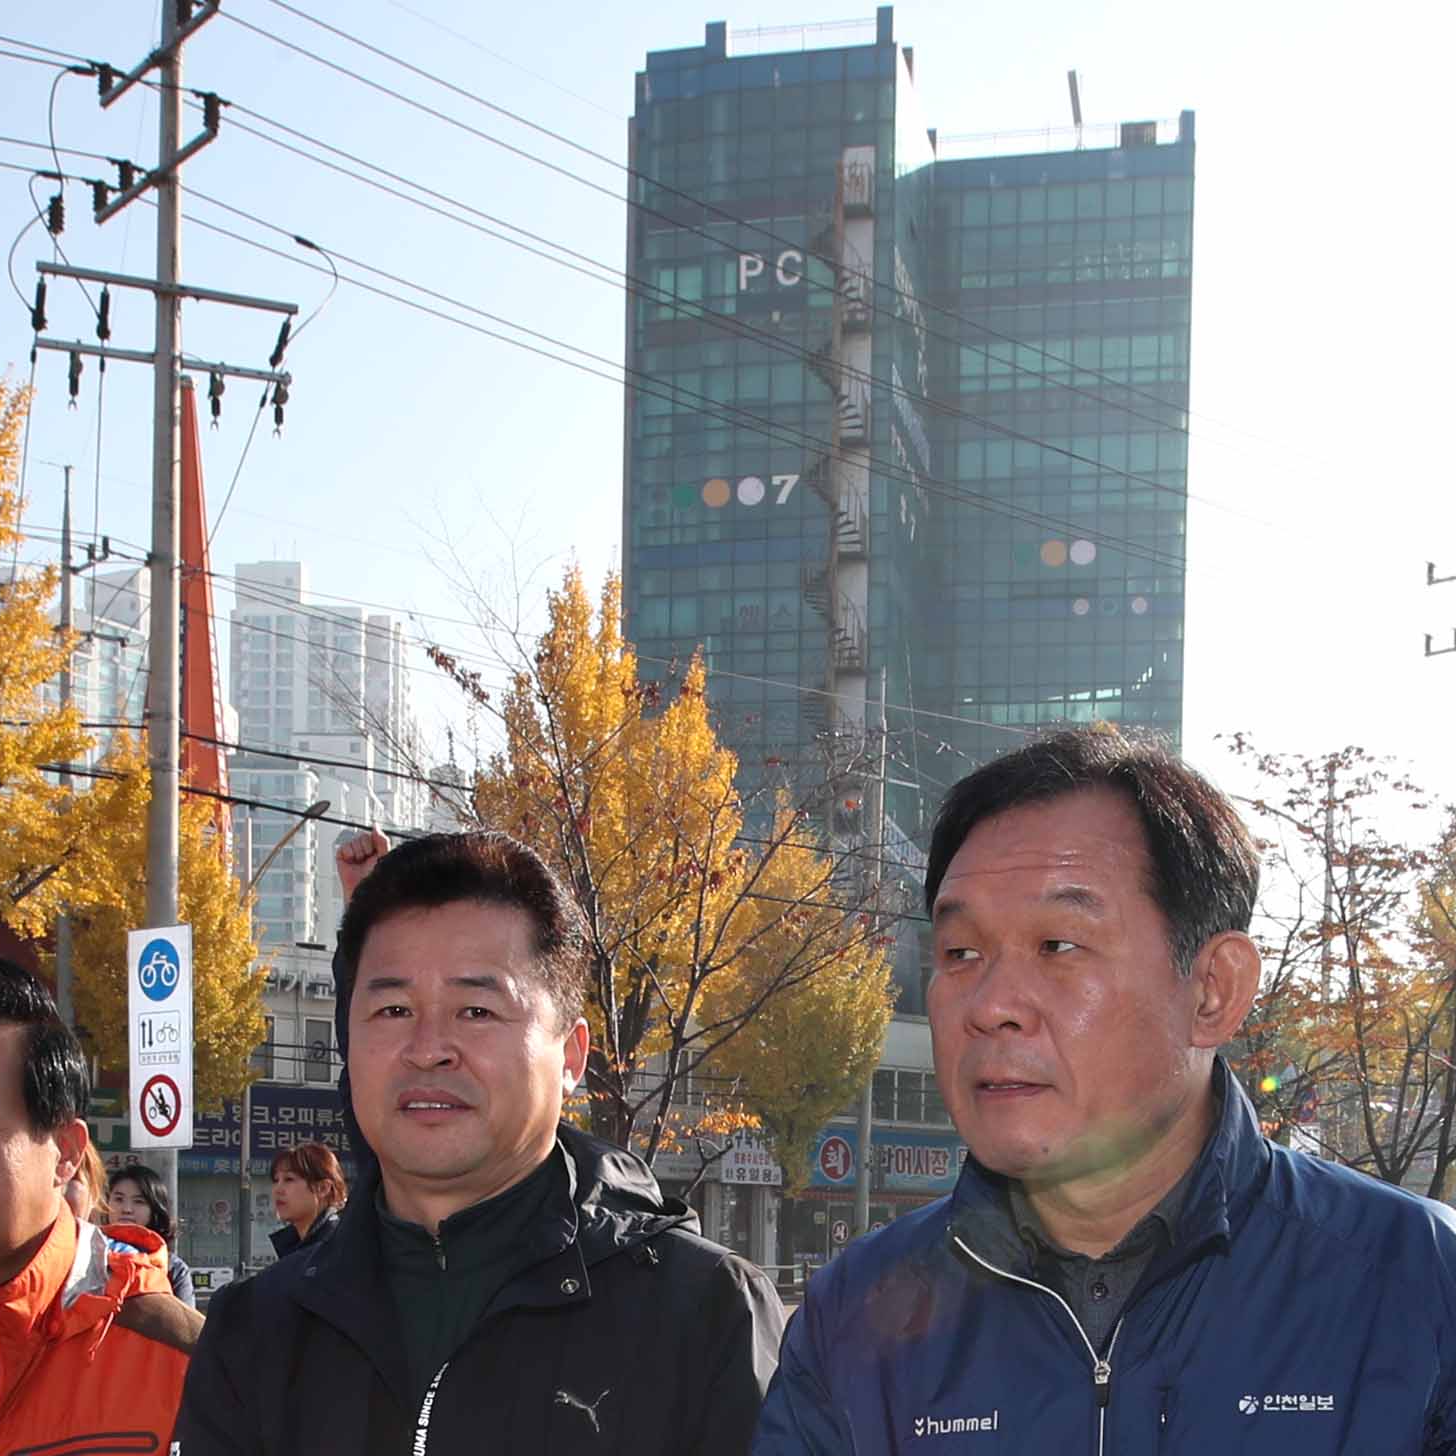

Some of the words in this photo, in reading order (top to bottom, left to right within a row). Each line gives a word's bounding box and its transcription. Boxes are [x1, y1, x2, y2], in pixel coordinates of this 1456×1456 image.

[738, 250, 804, 291] PC
[417, 1391, 436, 1427] SINCE
[1263, 1395, 1334, 1412] 인천일보
[927, 1410, 998, 1435] hummel
